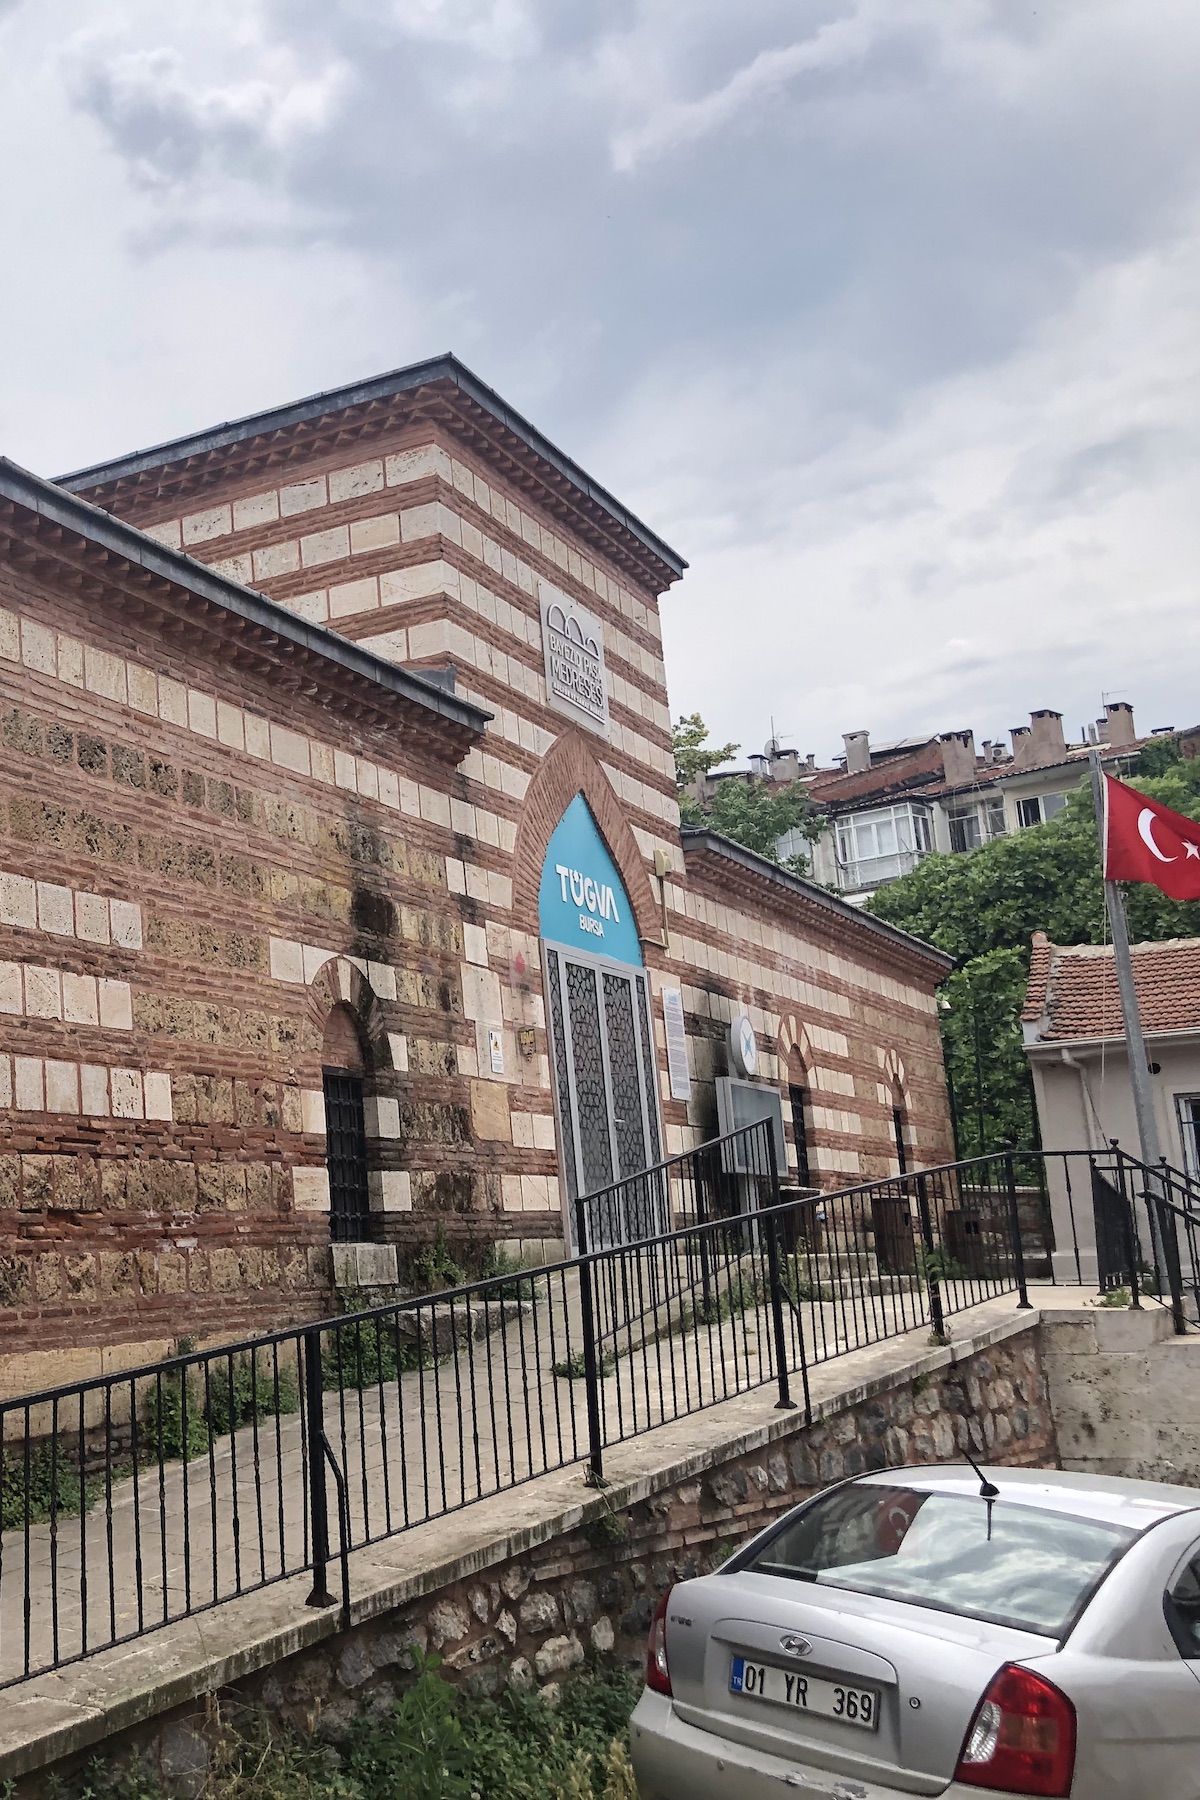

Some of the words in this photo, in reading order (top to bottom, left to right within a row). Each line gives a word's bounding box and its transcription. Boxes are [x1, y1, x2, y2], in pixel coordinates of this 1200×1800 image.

[555, 864, 620, 923] TÜGVA
[579, 913, 605, 938] BURSA
[733, 1676, 742, 1686] TR
[745, 1665, 765, 1694] 01
[784, 1673, 808, 1706] YR
[832, 1688, 872, 1722] 369
